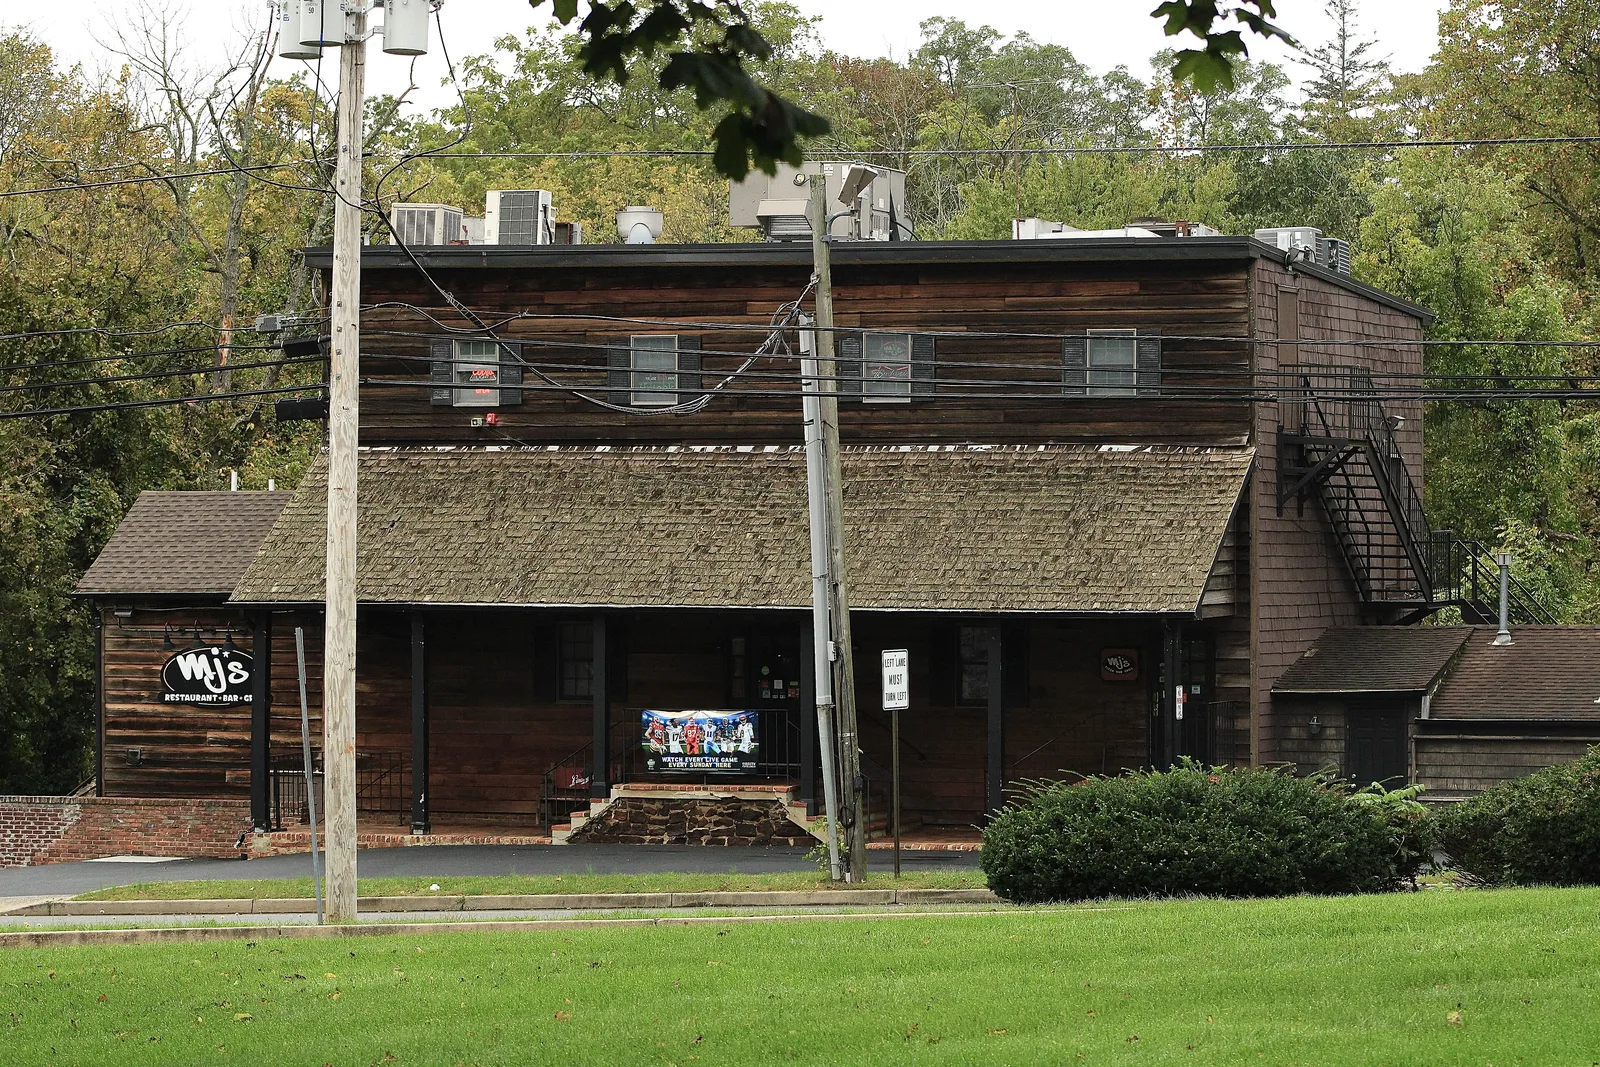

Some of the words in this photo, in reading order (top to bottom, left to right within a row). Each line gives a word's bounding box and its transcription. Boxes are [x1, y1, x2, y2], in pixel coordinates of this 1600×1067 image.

[884, 658, 895, 668] LEFT
[895, 657, 906, 667] LANE
[888, 673, 903, 685] MUST
[164, 693, 218, 702] RESTAURANT
[222, 694, 239, 702] BAR
[885, 692, 896, 701] TURN
[896, 691, 907, 700] LEFT
